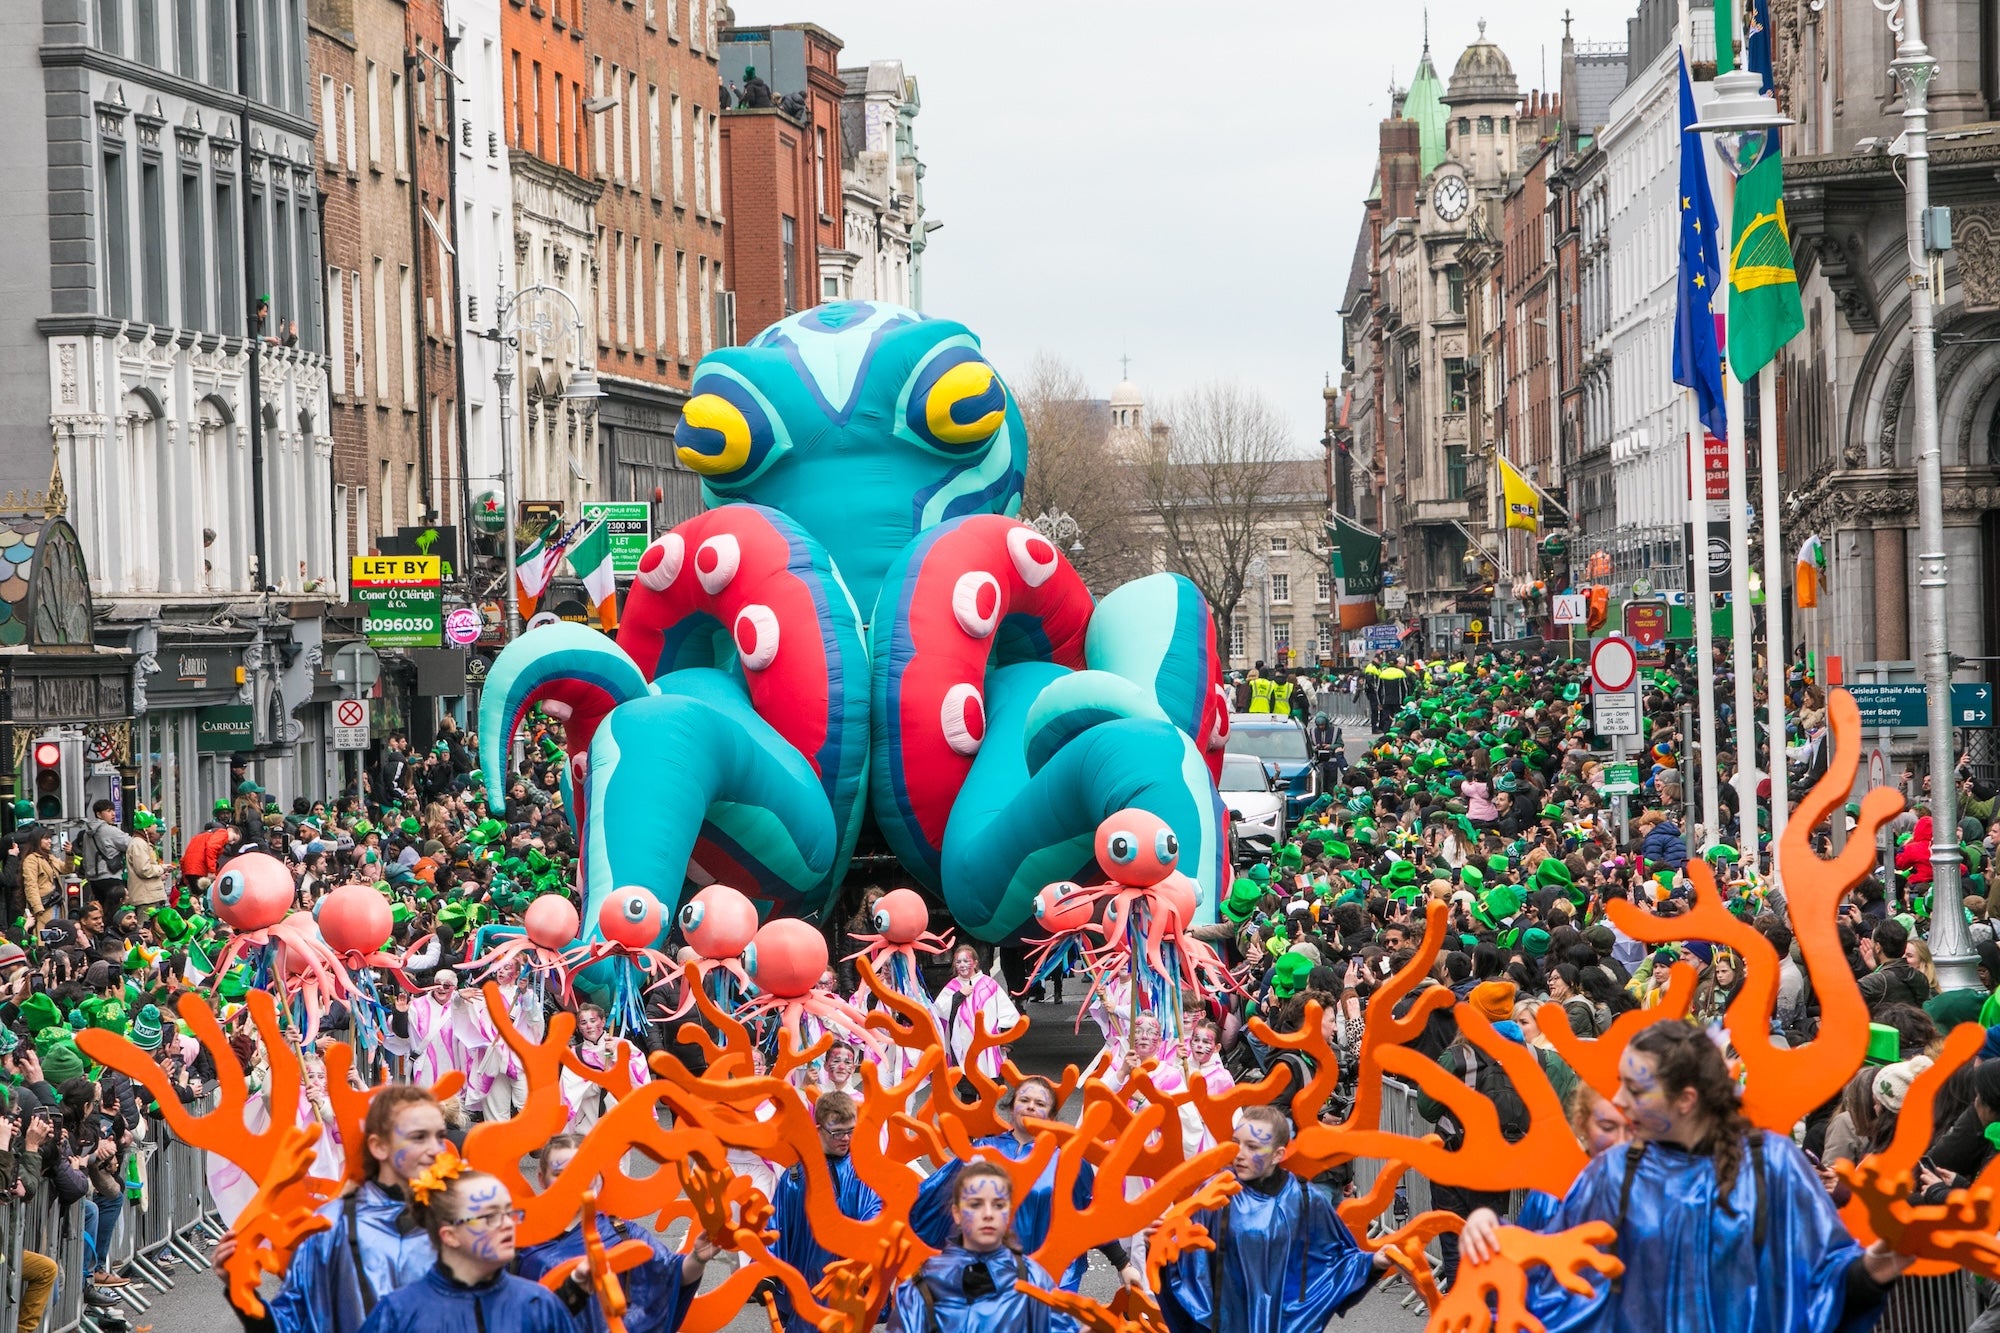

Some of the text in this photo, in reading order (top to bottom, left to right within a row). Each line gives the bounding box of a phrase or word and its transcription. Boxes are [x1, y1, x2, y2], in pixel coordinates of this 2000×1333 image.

[1705, 445, 1729, 455] ndia
[1712, 459, 1722, 469] &
[475, 515, 505, 523] Heineke
[364, 562, 397, 574] LET
[404, 561, 428, 574] BY
[359, 587, 435, 601] Conor Ó Cléirigh
[1575, 601, 1580, 617] L
[363, 618, 434, 632] 8096030
[1368, 628, 1373, 636] P
[1644, 633, 1650, 642] 9
[1904, 686, 1921, 694] Átha
[202, 721, 250, 731] CARROLLS
